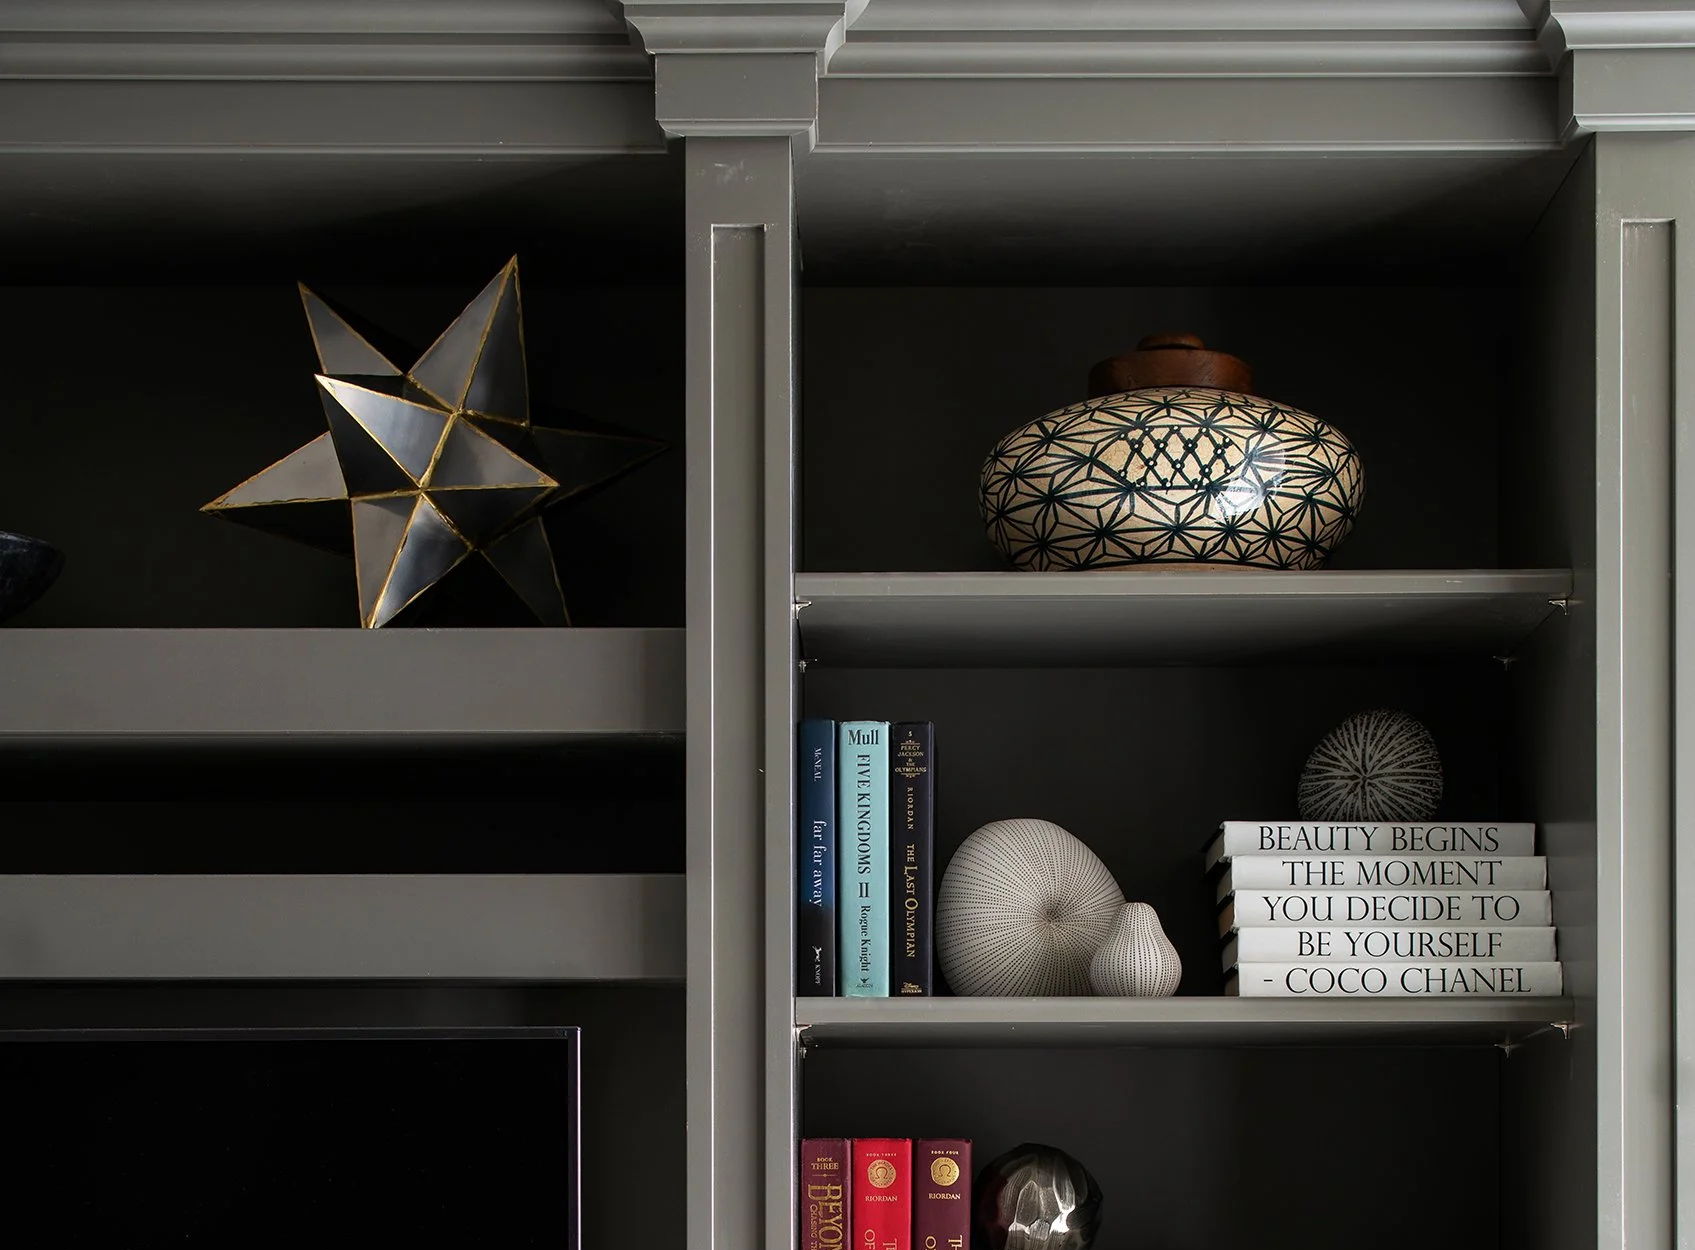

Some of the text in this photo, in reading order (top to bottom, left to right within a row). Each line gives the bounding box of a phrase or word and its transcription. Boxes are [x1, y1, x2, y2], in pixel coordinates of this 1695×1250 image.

[848, 729, 880, 746] Mull
[857, 754, 872, 875] FIVE KINGDOMS
[1258, 825, 1500, 852] BEAUTY BEGINS
[809, 820, 828, 907] far far away
[1281, 860, 1503, 887] THE MOMENT
[858, 882, 870, 898] II
[903, 843, 919, 959] THE LAST OLYMPIAN
[858, 905, 871, 937] Rogue
[1261, 895, 1520, 922] YOU DECIDE TO
[859, 939, 872, 972] Knight
[1297, 931, 1503, 958] BE YOURSELF
[1285, 967, 1388, 994] COCO
[1400, 967, 1532, 994] CHANEL
[810, 1162, 840, 1170] THREE
[928, 1192, 961, 1200] RIORDAN
[809, 1204, 818, 1238] CHASING
[864, 1229, 876, 1250] OF
